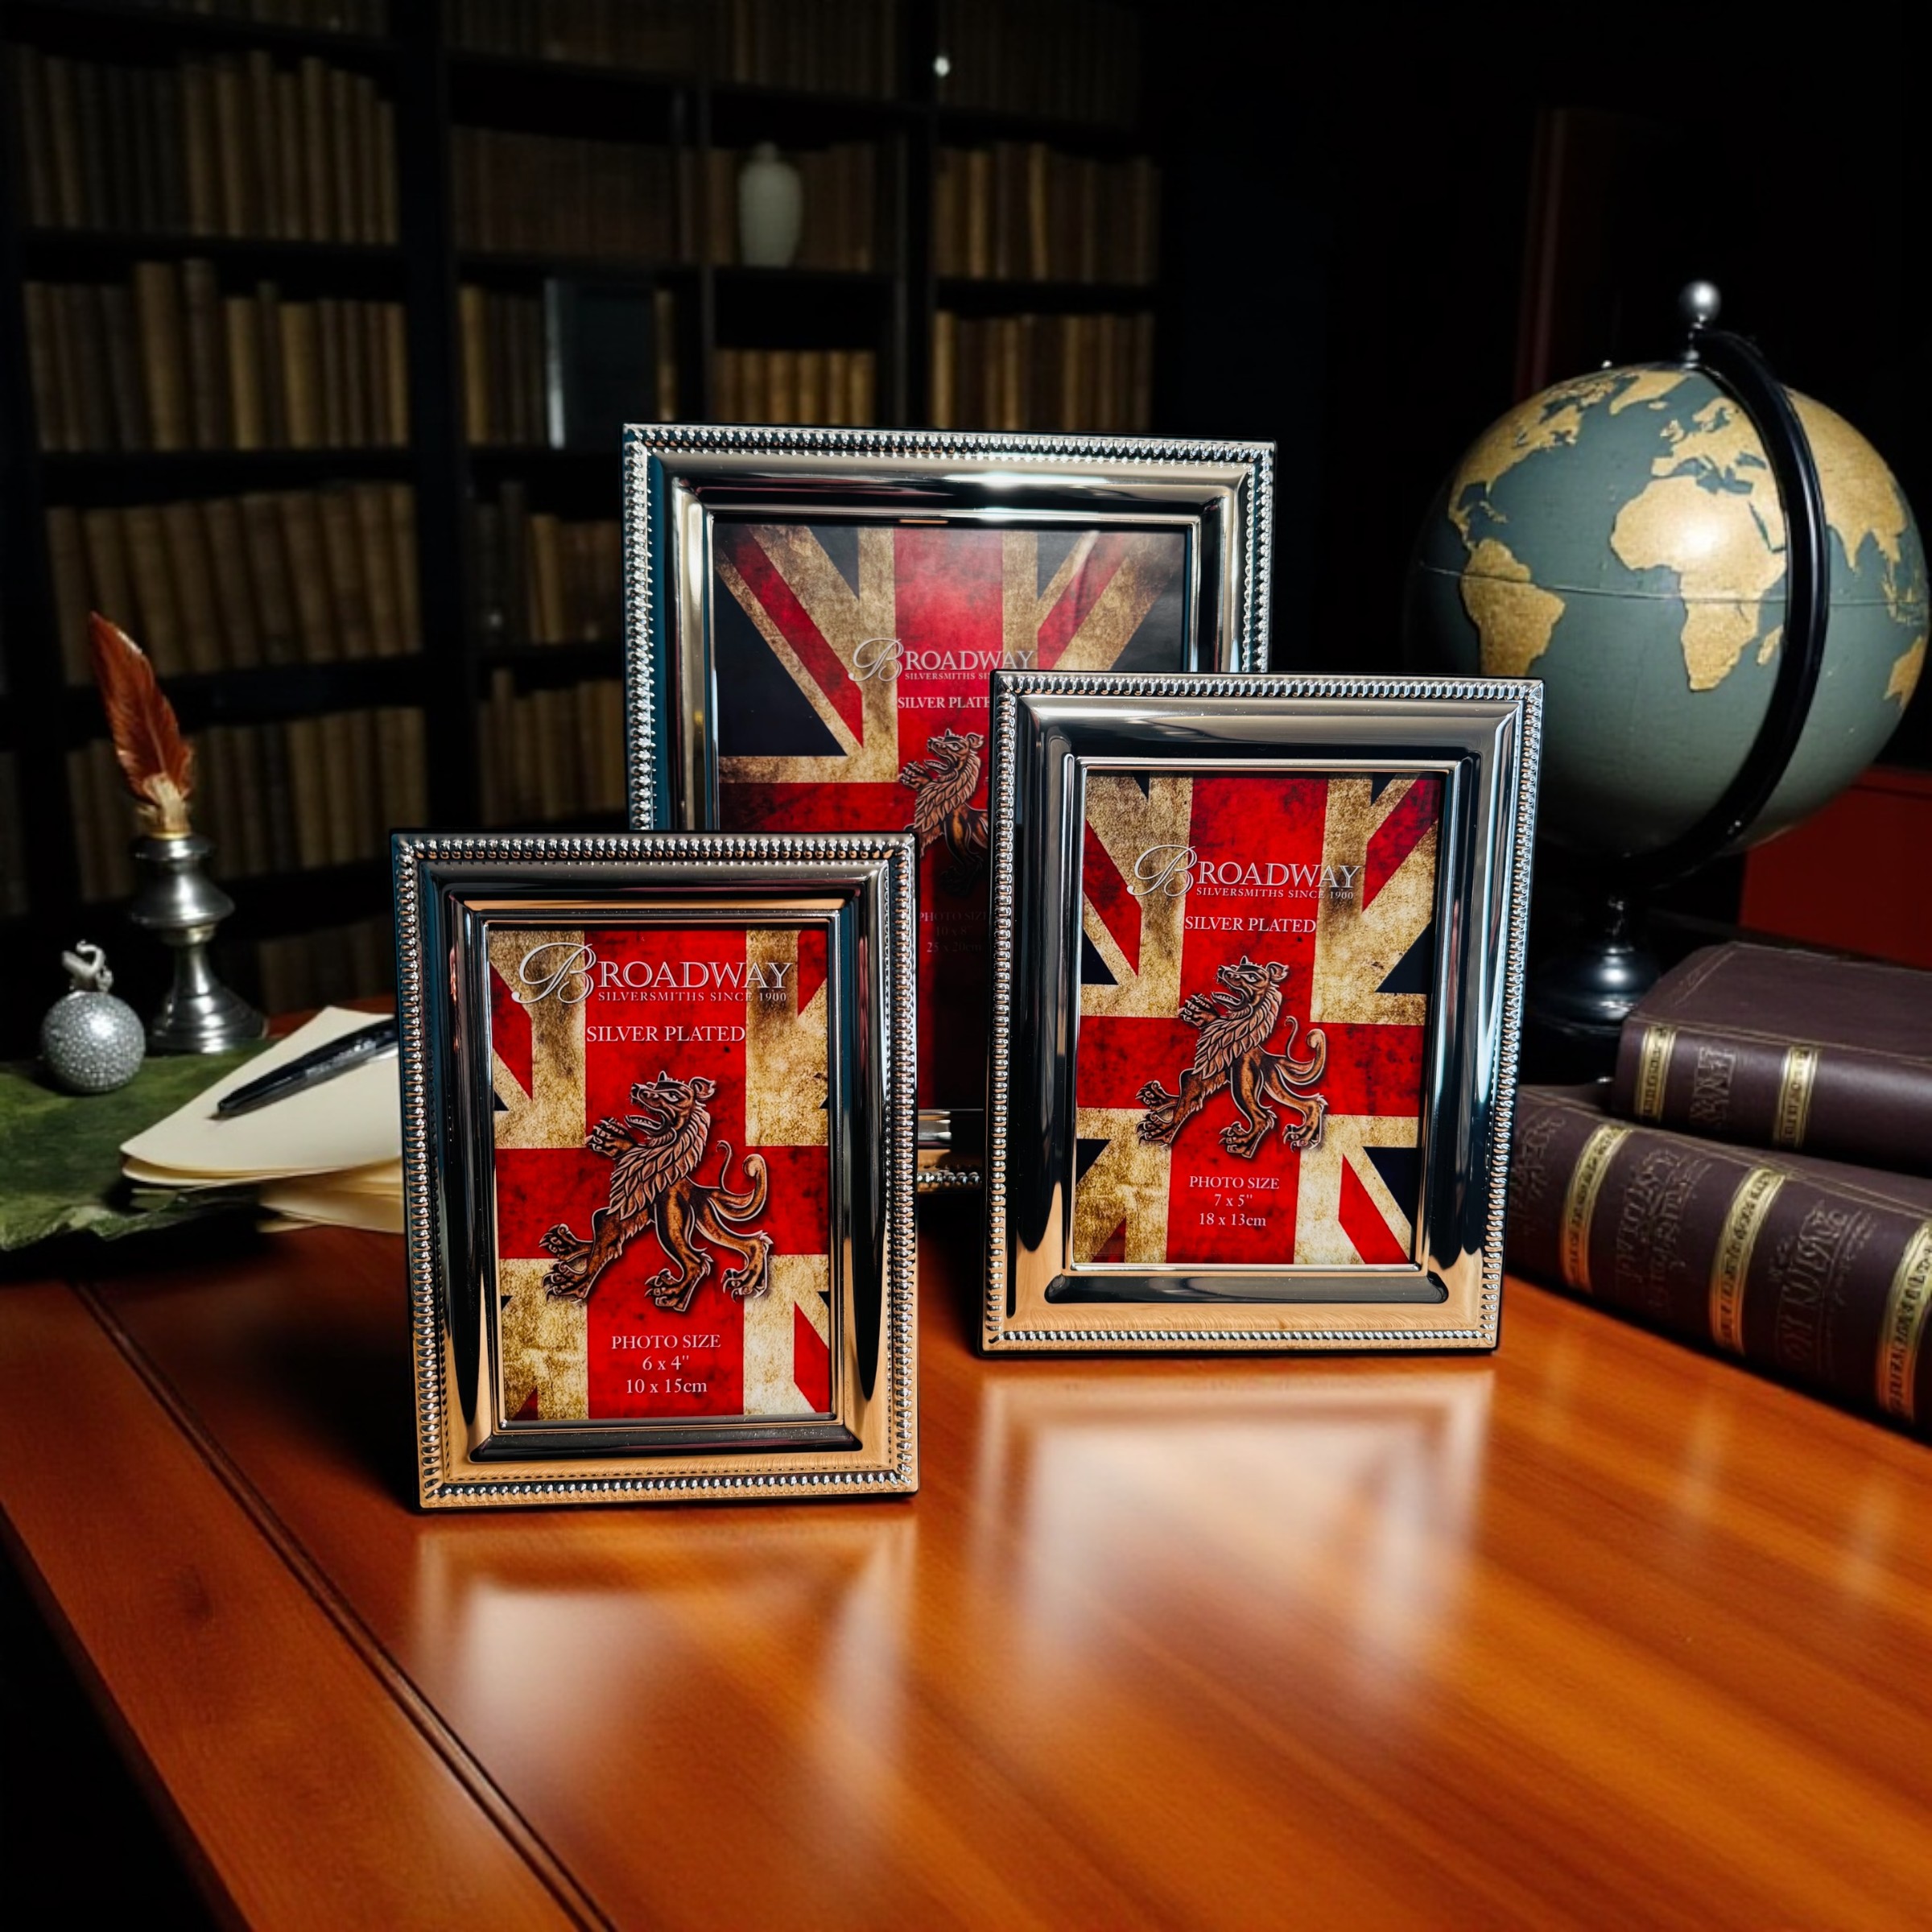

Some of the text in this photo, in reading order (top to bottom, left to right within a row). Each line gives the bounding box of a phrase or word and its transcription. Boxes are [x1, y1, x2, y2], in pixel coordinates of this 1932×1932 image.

[905, 672, 976, 680] SILVERSMITHS
[898, 696, 990, 708] SILVER PLATE
[1127, 844, 1362, 898] BROADWAY
[1196, 887, 1284, 898] SILVERSMITHS
[1288, 890, 1325, 898] SINCE
[1184, 916, 1317, 933] SILVER PLATED
[511, 942, 793, 1004] BROADWAY
[598, 991, 705, 1002] SILVERSMITHS
[710, 992, 753, 1002] SINCE
[586, 1025, 745, 1042] SILVER PLATED
[1189, 1175, 1280, 1190] PHOTO SIZE
[1214, 1194, 1222, 1207] 7
[1225, 1197, 1233, 1207] x
[1199, 1212, 1266, 1226] 18 x 13cm
[611, 1334, 721, 1349] PHOTO SIZE
[642, 1356, 653, 1371] 6
[658, 1360, 667, 1370] x
[626, 1378, 708, 1393] 10 x 15cm
